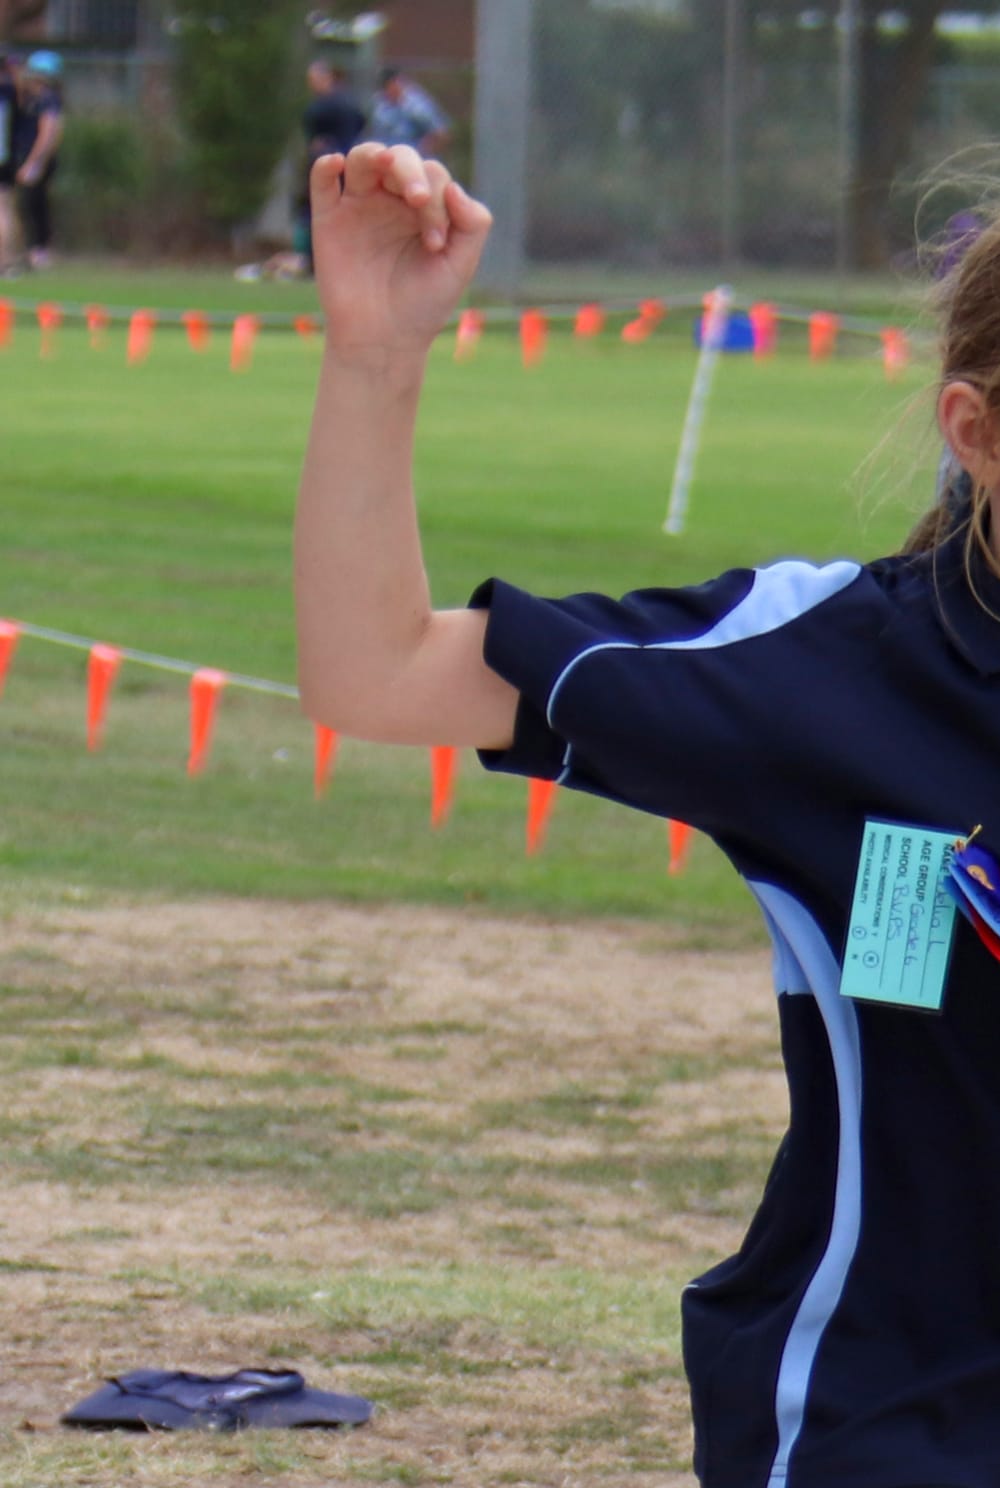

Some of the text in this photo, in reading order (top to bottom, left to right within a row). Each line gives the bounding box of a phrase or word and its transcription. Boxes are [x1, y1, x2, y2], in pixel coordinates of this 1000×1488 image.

[882, 834, 892, 865] MEDICAL
[897, 837, 912, 879] SCHOOL
[920, 839, 932, 862] AGE
[915, 864, 929, 902] GROUP
